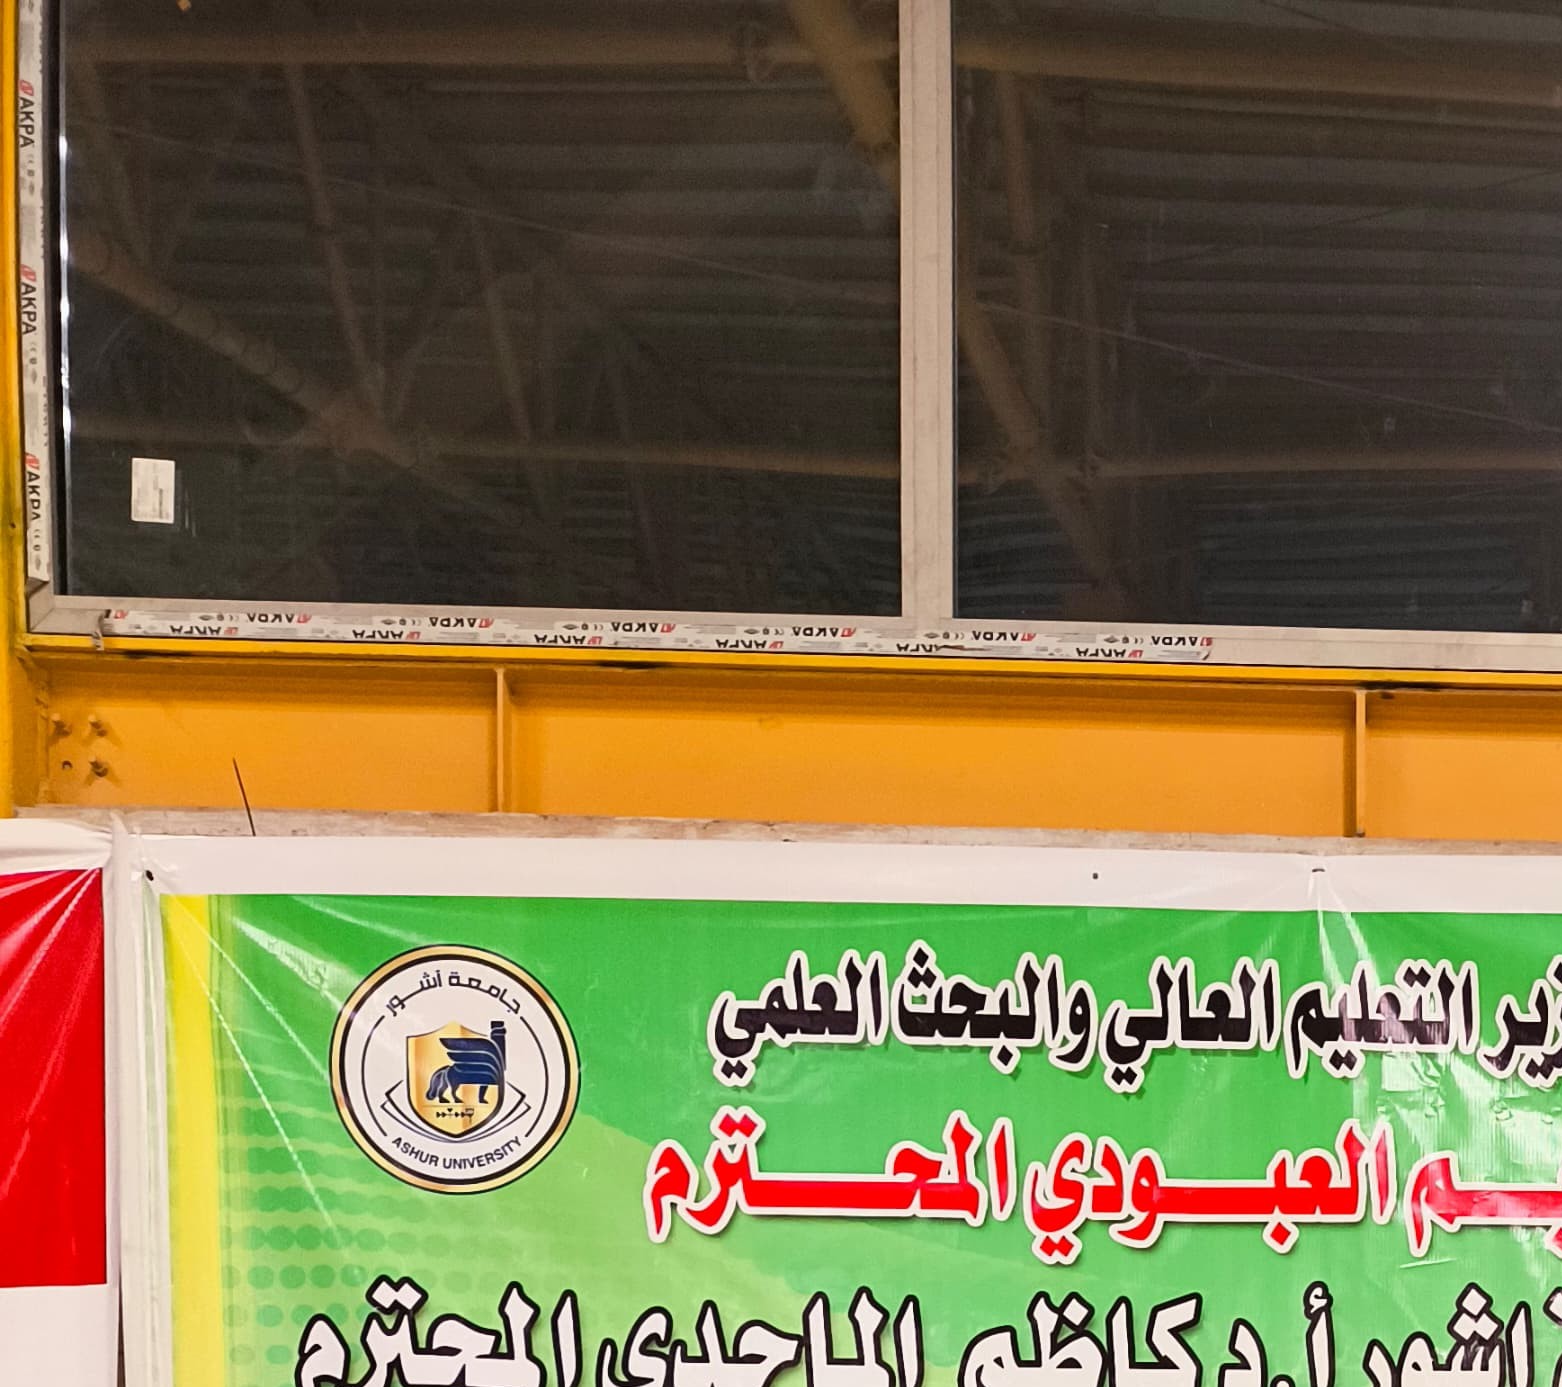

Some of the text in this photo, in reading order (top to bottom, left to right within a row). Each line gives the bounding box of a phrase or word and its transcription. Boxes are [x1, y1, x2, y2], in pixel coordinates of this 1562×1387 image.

[19, 97, 36, 148] AKPA
[21, 282, 38, 336] AKPA
[448, 971, 521, 1015] جامعة
[712, 952, 888, 1080] العلمي
[896, 946, 1094, 1067] والبحث
[1103, 958, 1275, 1085] العالي
[1289, 962, 1476, 1076] التعليم
[391, 1135, 523, 1170] ASHUR UNIVERSITY
[648, 1108, 1018, 1242] المحترم
[1030, 1122, 1392, 1259] العبودي
